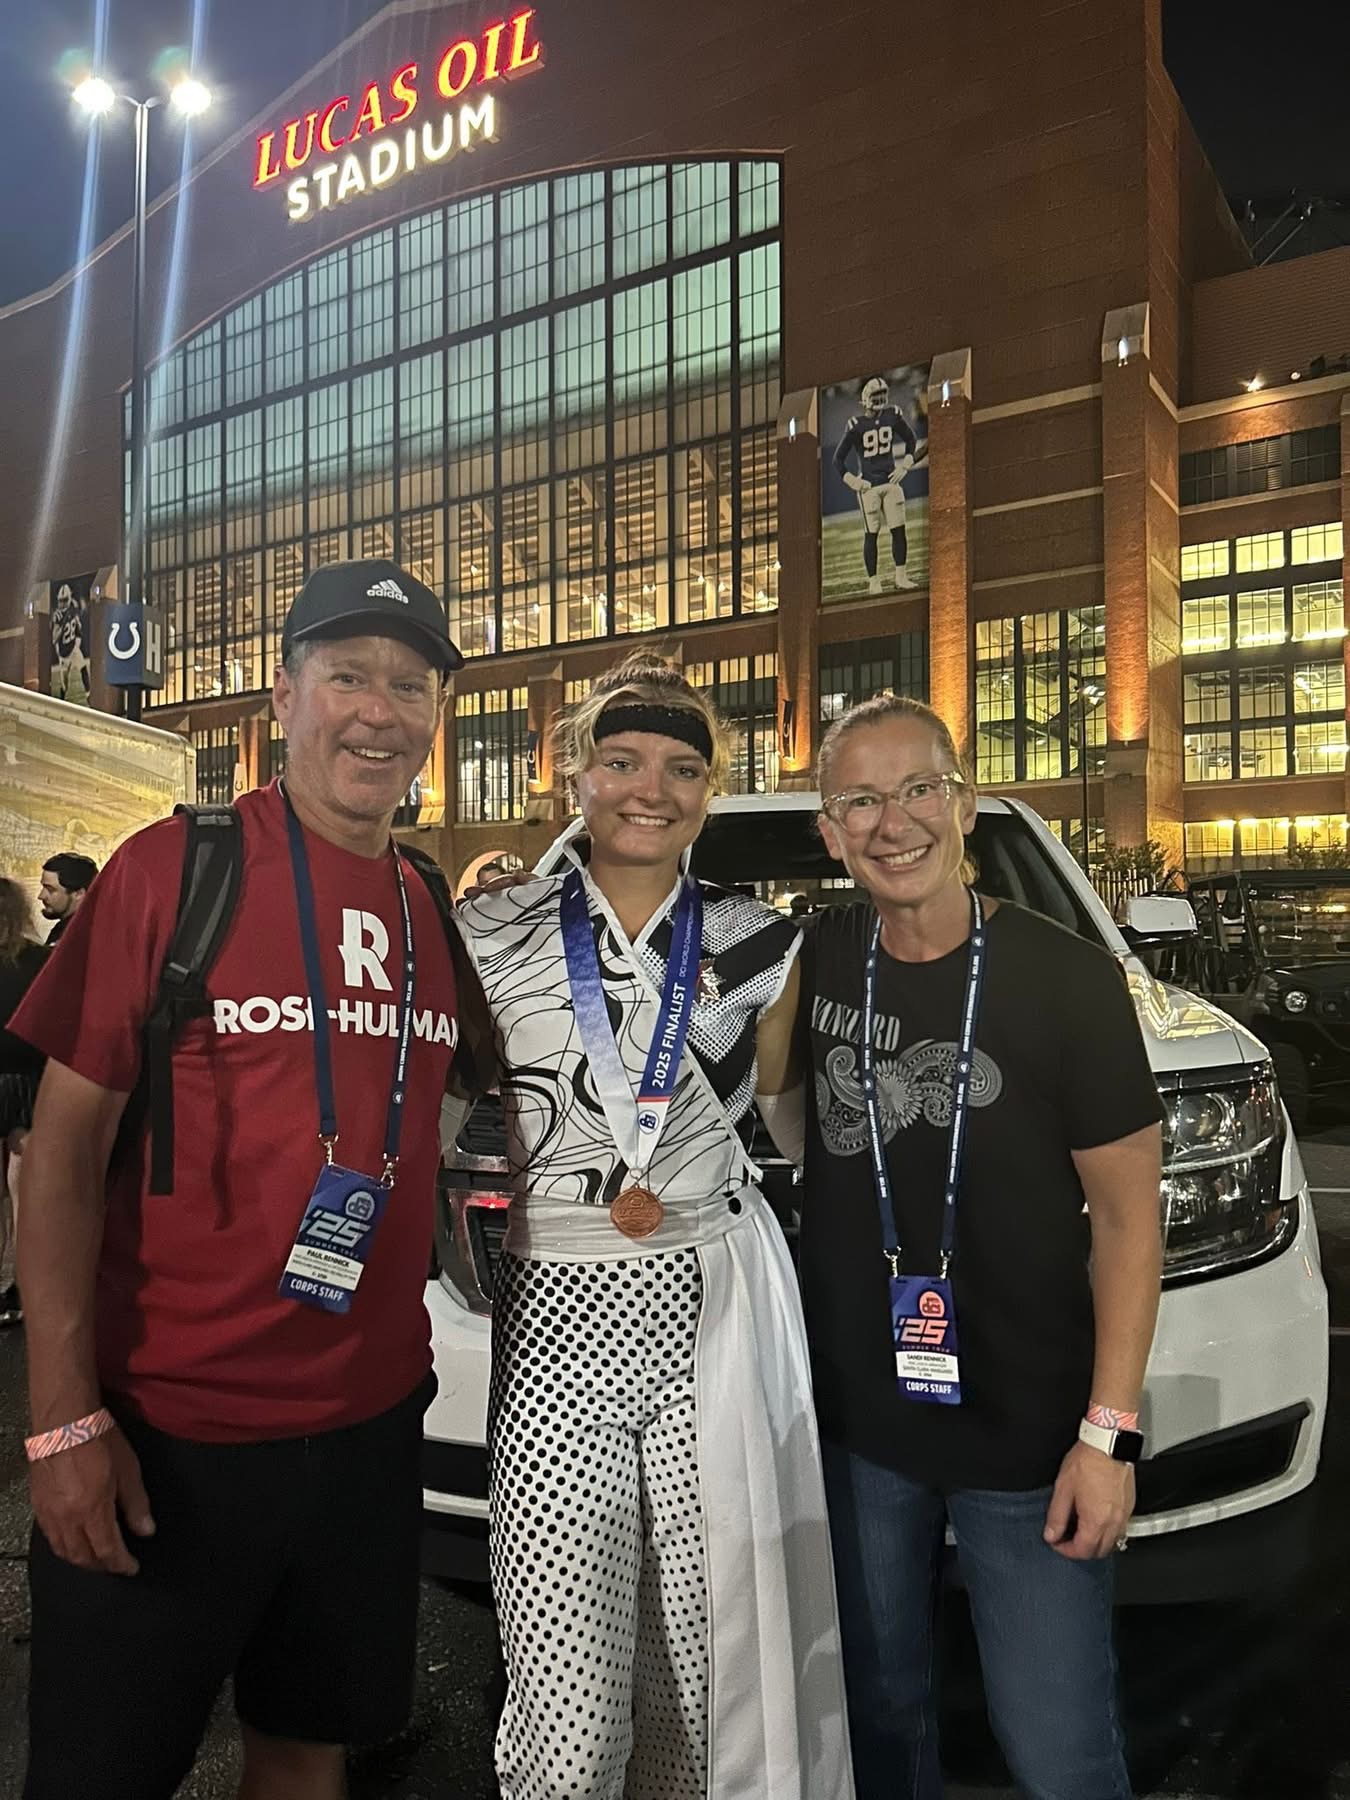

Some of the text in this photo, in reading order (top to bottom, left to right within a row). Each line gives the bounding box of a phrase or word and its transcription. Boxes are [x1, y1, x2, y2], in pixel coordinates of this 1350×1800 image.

[253, 9, 543, 190] LUCAS OIL
[286, 93, 496, 219] STADIUM
[862, 426, 893, 458] 99
[366, 588, 409, 604] adidas
[62, 621, 77, 645] 28
[145, 620, 161, 674] H
[338, 908, 394, 991] R
[681, 944, 690, 965] WORLD
[652, 983, 686, 1088] 2025 FINALIST
[307, 1249, 323, 1260] PAUL
[323, 1254, 350, 1268] RENNICK
[290, 1278, 344, 1301] CORPS STAFF
[906, 1381, 952, 1394] CORPS STAFF
